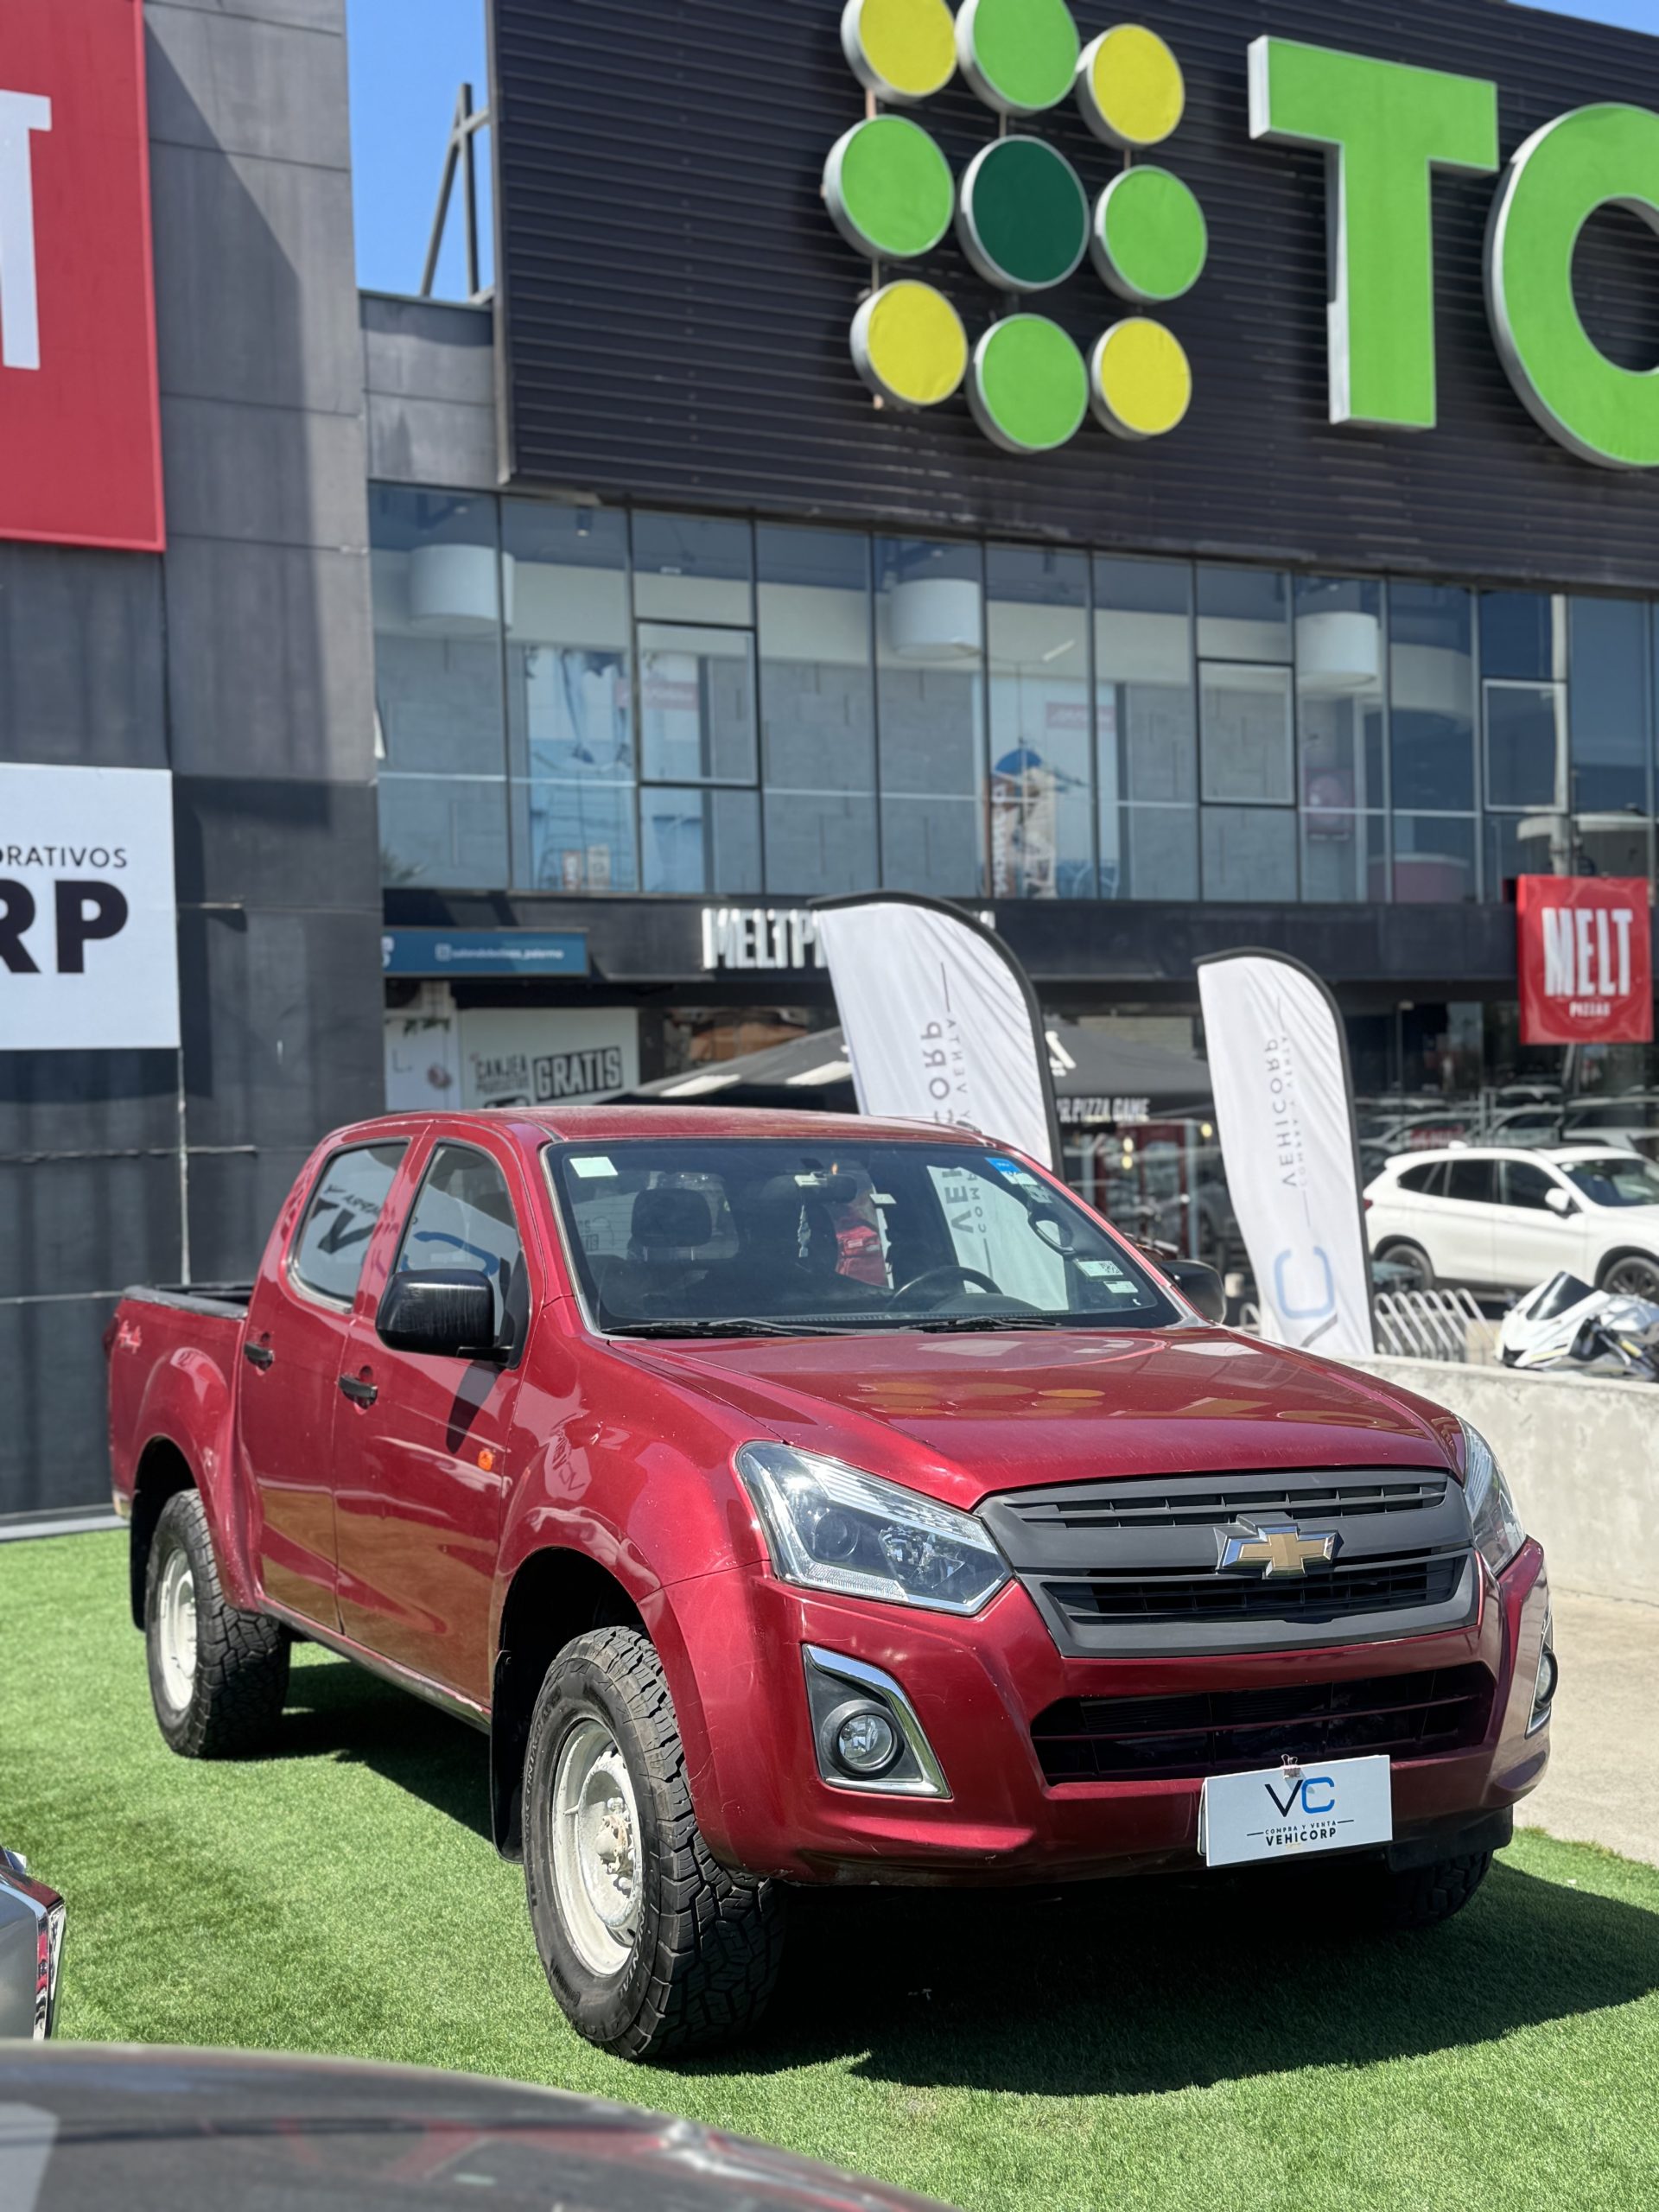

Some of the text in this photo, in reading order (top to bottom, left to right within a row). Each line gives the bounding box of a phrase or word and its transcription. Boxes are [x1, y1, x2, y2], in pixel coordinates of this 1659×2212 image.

[0, 844, 128, 868] RATIVOS
[1541, 906, 1633, 997] MELT
[535, 1048, 621, 1100] GRATIS
[1071, 1096, 1111, 1122] PIZZA
[1264, 1777, 1335, 1817] VC
[1265, 1826, 1298, 1835] COMPRA
[1311, 1821, 1337, 1829] VENTA
[1266, 1827, 1337, 1847] VEHICORP
